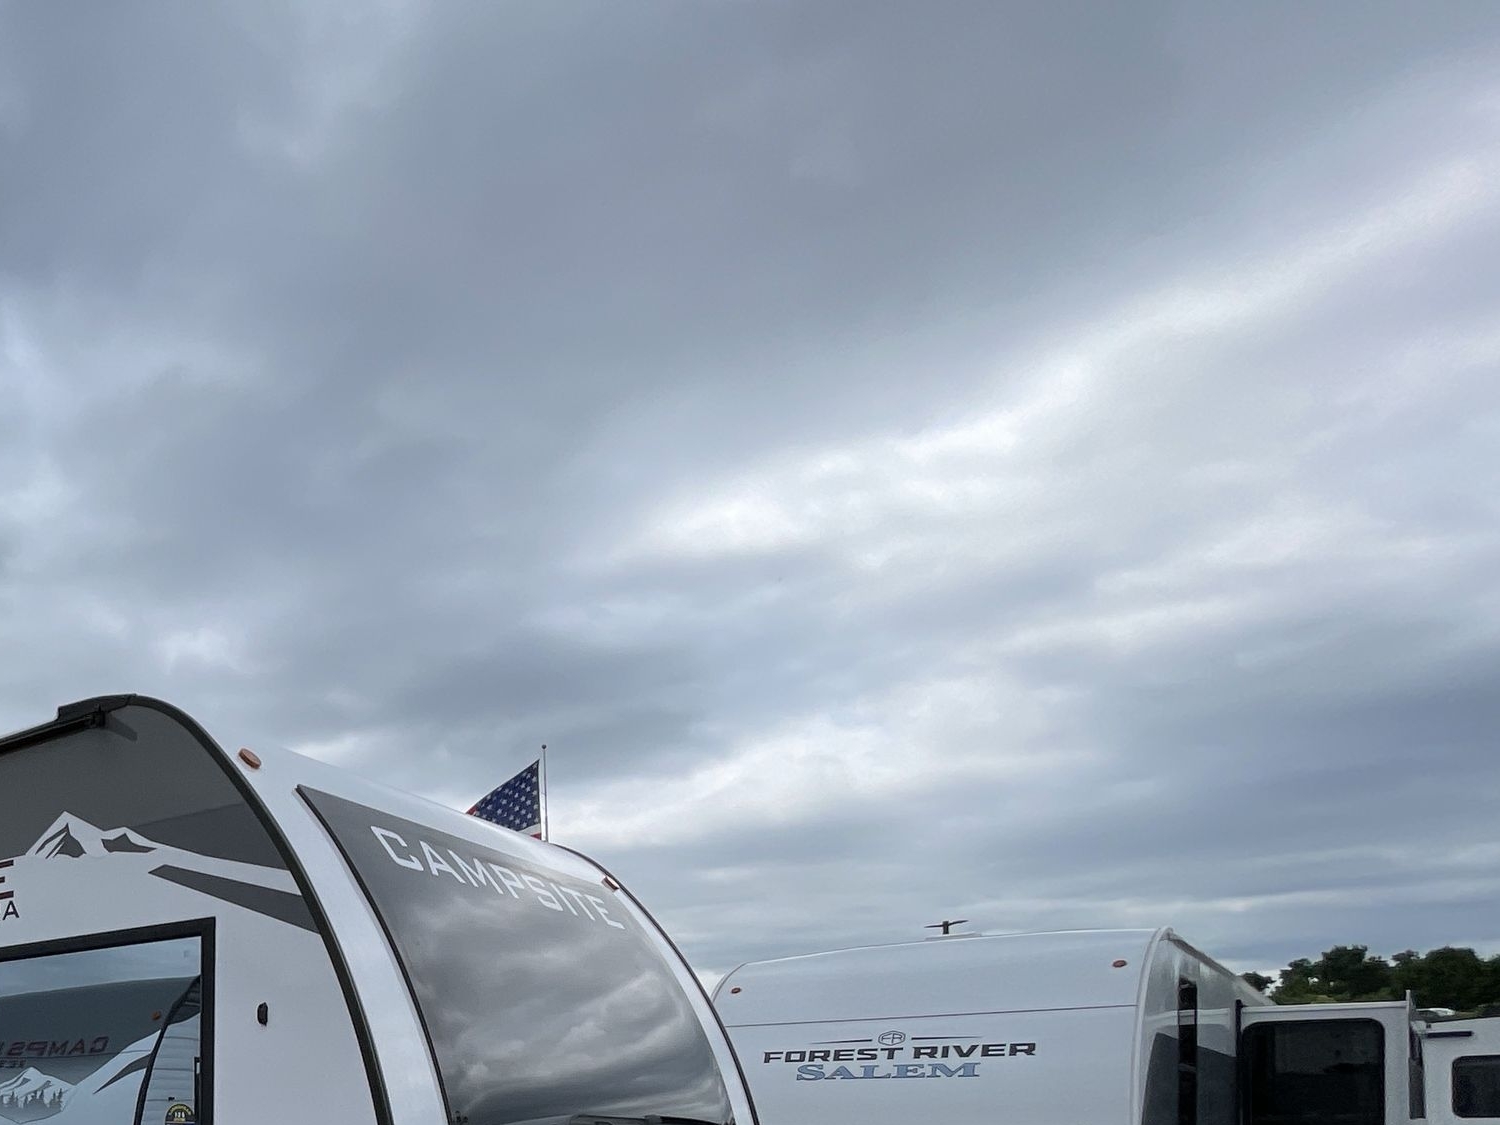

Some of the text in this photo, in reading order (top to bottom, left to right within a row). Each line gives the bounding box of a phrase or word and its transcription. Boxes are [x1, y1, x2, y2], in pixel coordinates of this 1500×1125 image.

[370, 825, 625, 929] CAMPSITE
[763, 1042, 1036, 1064] FOREST RIVER
[796, 1062, 981, 1081] SALEM
